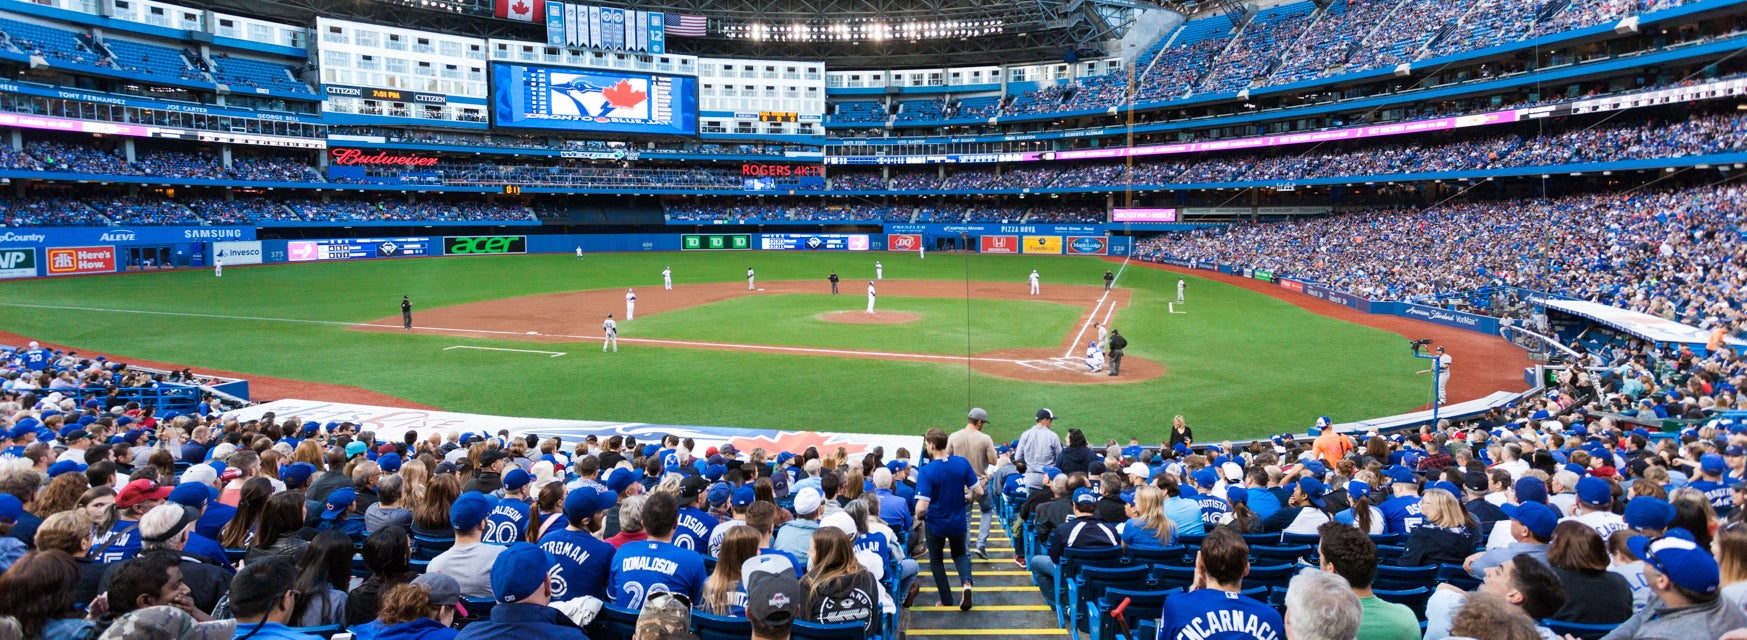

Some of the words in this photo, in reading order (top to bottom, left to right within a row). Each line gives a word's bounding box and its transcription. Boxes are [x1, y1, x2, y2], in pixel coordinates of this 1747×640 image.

[650, 30, 662, 41] 12
[326, 86, 360, 95] CITIZEN
[83, 94, 126, 104] FERNANDEZ
[416, 94, 446, 103] CITIZEN
[332, 148, 438, 166] Budweiser
[742, 164, 790, 176] ROGERS
[100, 232, 136, 241] ALEVE
[185, 230, 241, 238] SAMSUNG
[451, 237, 519, 254] acer
[77, 250, 111, 260] Here's
[78, 260, 105, 269] How.
[1406, 306, 1429, 317] American
[1428, 310, 1455, 321] Standard
[1199, 499, 1227, 512] AUTISTA
[491, 506, 523, 522] ALDSON
[482, 520, 518, 543] 20
[677, 514, 708, 538] LDSON
[540, 541, 590, 564] TROMAN
[623, 556, 678, 576] DONALDSON
[850, 591, 867, 604] AND
